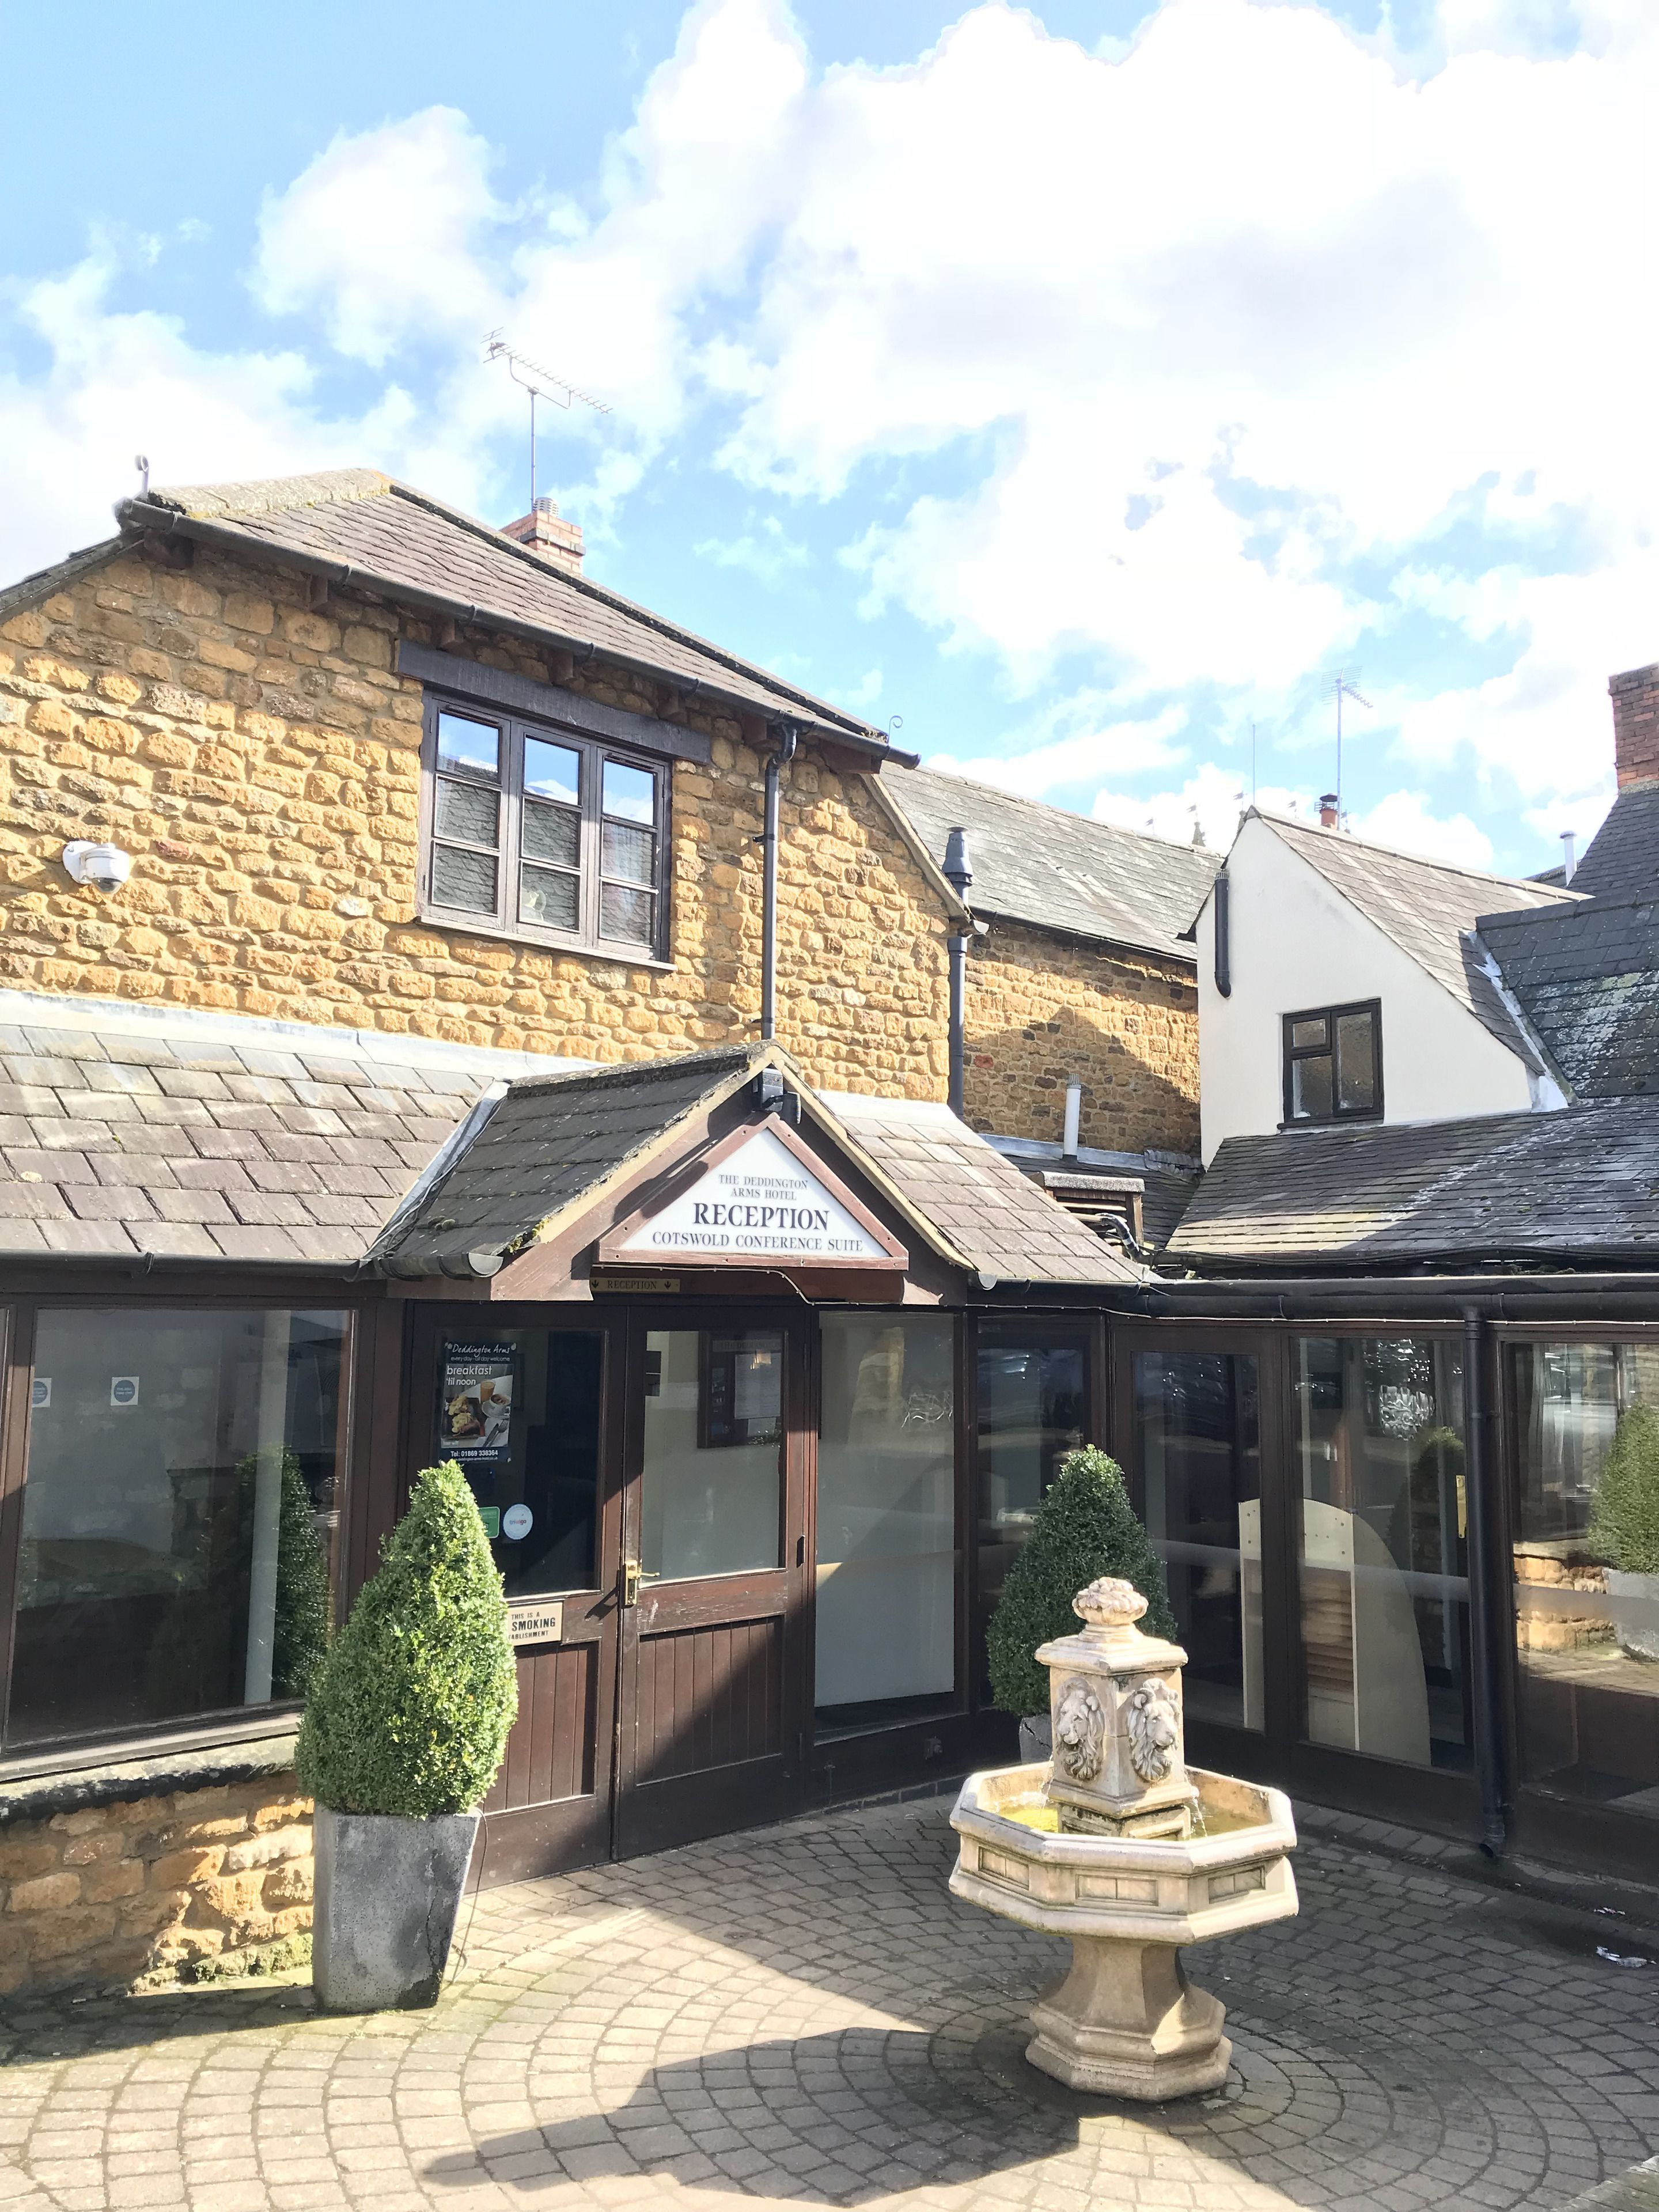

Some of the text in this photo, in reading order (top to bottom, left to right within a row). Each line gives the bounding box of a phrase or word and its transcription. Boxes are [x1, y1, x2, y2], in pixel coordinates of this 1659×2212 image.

[719, 1174, 808, 1190] THE DEDDINGTON
[730, 1188, 797, 1201] ARMS HOTEL
[692, 1202, 830, 1231] RECEPTION
[652, 1231, 863, 1252] COTSWOLD CONFERENCE SUITE
[607, 1280, 657, 1290] RECEPTION
[452, 1343, 510, 1357] Deddington Arms
[447, 1365, 492, 1375] breakfast
[512, 1618, 556, 1631] SMOKING
